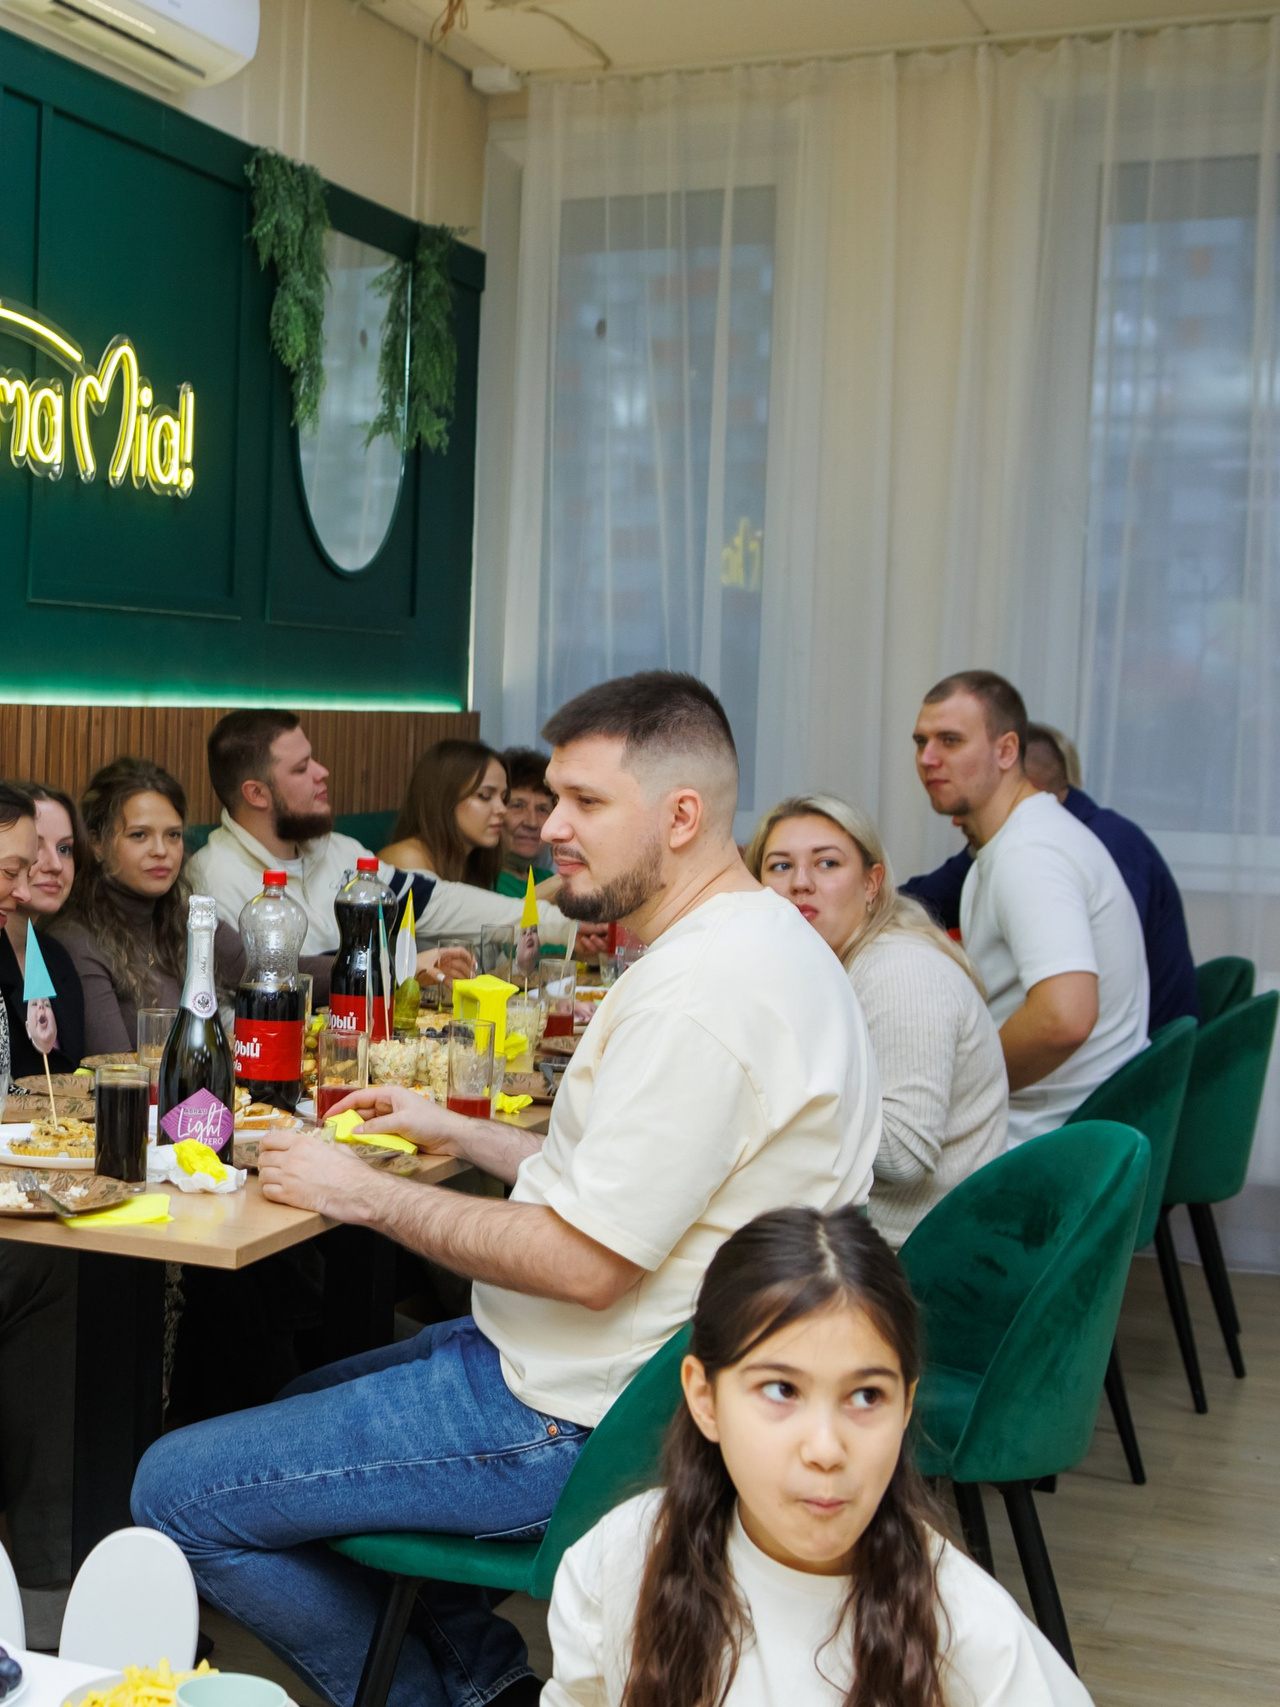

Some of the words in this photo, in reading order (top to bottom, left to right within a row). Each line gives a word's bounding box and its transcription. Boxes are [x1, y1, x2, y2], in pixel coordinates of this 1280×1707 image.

[74, 343, 196, 492] Mia!
[329, 1009, 357, 1030] рый
[233, 1035, 260, 1058] рый
[177, 1102, 228, 1144] Light
[203, 1136, 224, 1146] ZERO
